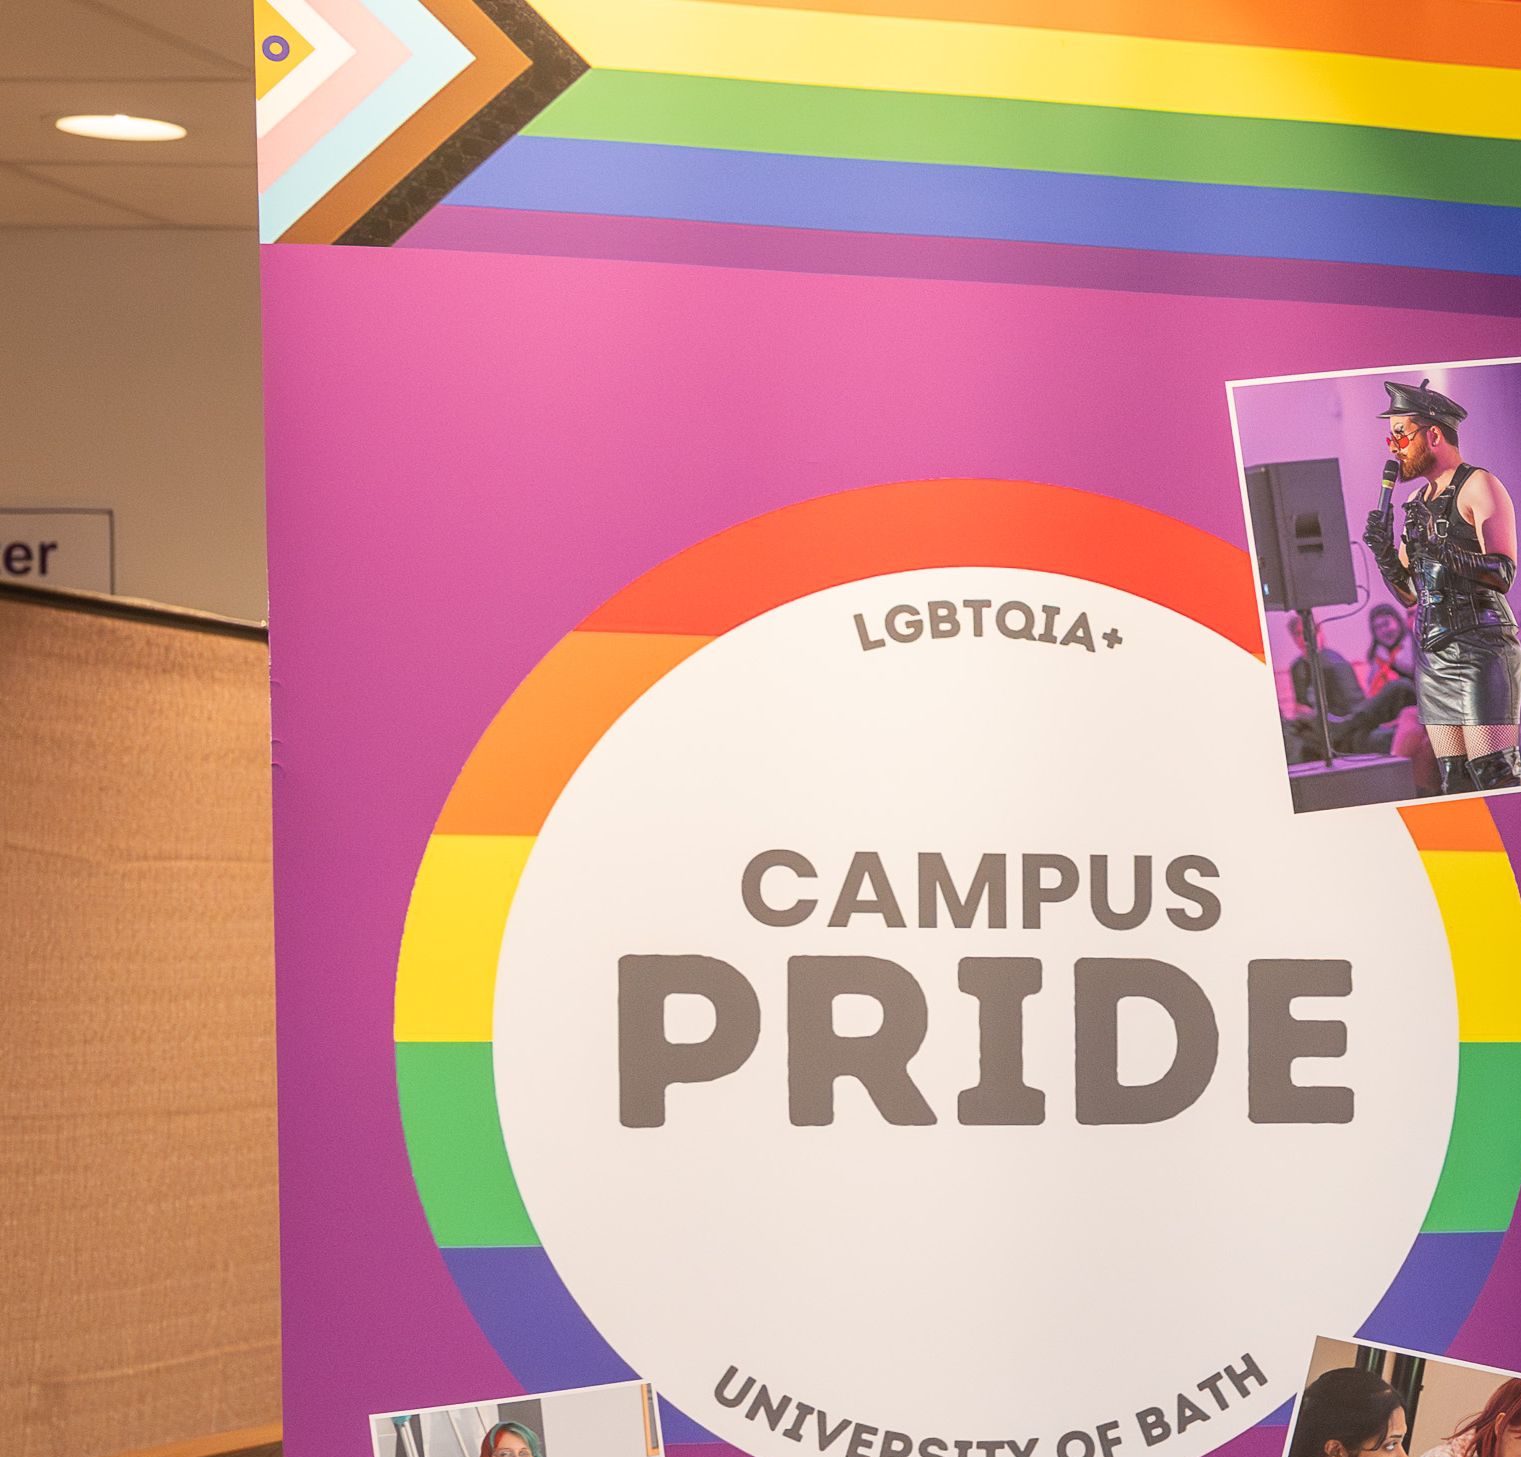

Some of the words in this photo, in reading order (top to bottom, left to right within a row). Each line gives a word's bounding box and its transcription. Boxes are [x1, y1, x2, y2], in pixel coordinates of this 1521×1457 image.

[852, 598, 1125, 654] LGBTQIA+
[740, 847, 1224, 933] CAMPUS
[617, 953, 1357, 1130] PRIDE
[1134, 1352, 1269, 1448] BATH
